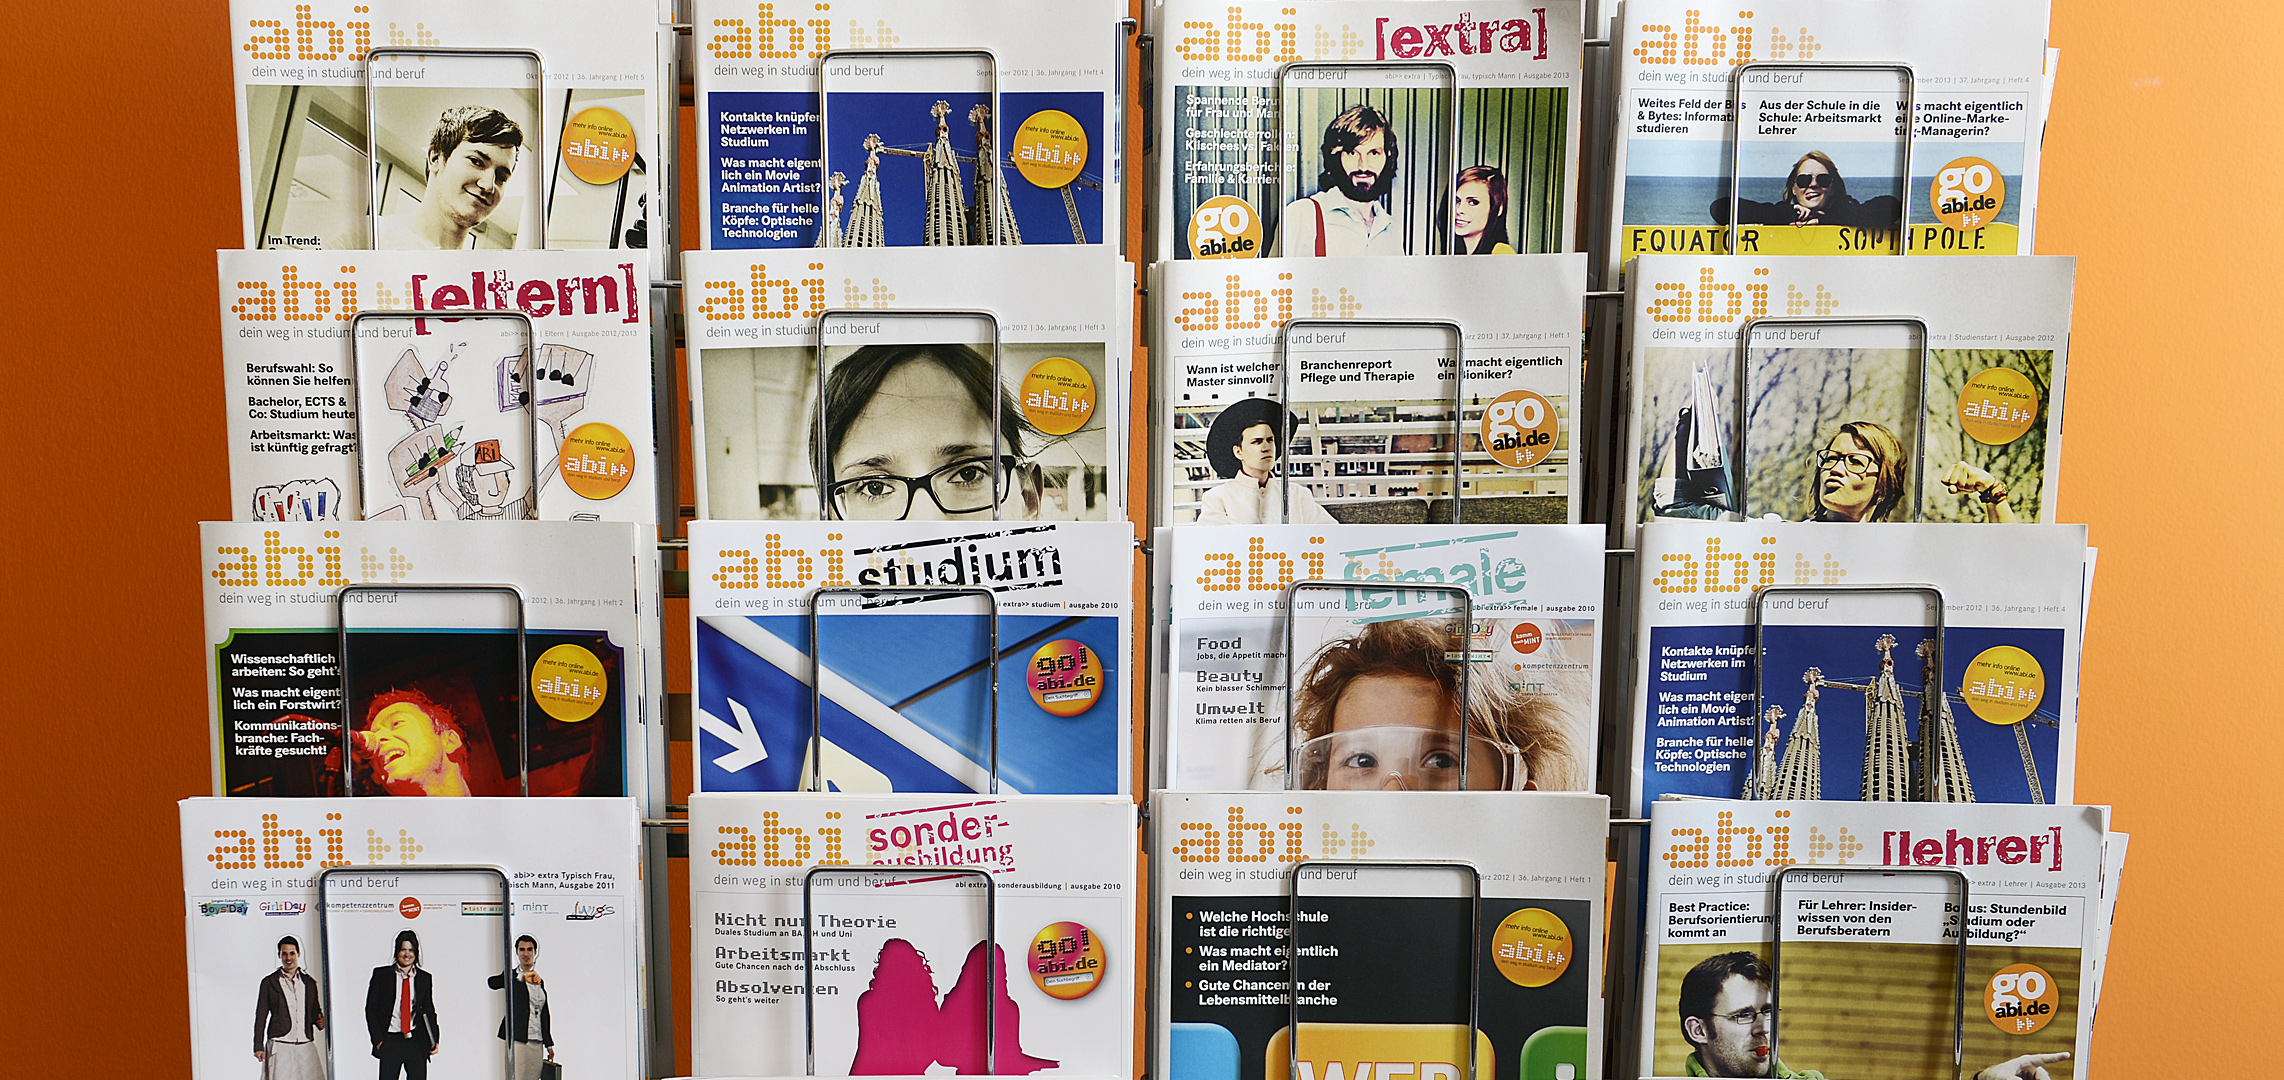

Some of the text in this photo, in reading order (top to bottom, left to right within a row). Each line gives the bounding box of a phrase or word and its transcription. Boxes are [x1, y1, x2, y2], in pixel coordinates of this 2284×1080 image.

[243, 5, 378, 61] abi
[707, 3, 830, 59] abi
[1176, 6, 1302, 62] abi
[1633, 9, 1757, 65] abi
[252, 66, 276, 77] dein
[280, 68, 304, 80] weg
[307, 67, 318, 77] in
[395, 68, 425, 79] beruf
[1182, 67, 1243, 81] dein weg in
[1186, 95, 1248, 106] Spannende
[1638, 98, 1722, 109] Weites Feld der
[720, 112, 773, 122] Kontakte
[1186, 107, 1253, 118] für Frau und
[1636, 124, 1689, 134] studieren
[1758, 125, 1797, 135] Lehrer
[721, 137, 769, 147] Studium
[567, 139, 609, 161] abi
[721, 158, 785, 168] Was macht
[1938, 165, 1993, 209] go
[722, 203, 819, 213] Branche für helle
[722, 215, 813, 228] Köpfe: Optische
[1196, 205, 1249, 250] go
[268, 235, 320, 245] Im Trend:
[722, 228, 798, 240] Technologien
[1925, 226, 1986, 250] POLE
[1200, 236, 1254, 256] abi.de
[231, 265, 358, 321] abi
[698, 262, 826, 321] abi
[1646, 267, 1773, 323] abi
[1174, 272, 1293, 331] abi
[707, 325, 772, 339] dein weg in
[1765, 329, 1821, 340] und beruf
[246, 363, 334, 373] Berufswahl: So
[1187, 362, 1280, 375] Wann ist welcher
[1300, 359, 1392, 370] Branchenreport
[247, 376, 351, 386] können Sie helfen
[1187, 374, 1275, 387] Master sinnvoll?
[1300, 371, 1415, 384] Pflege und Therapie
[248, 397, 346, 409] Bachelor, ECTS &
[1026, 390, 1069, 411] abi
[1963, 399, 2008, 421] abi
[1488, 398, 1545, 444] go
[212, 531, 349, 587] abi
[712, 533, 851, 589] abi
[1197, 537, 1330, 592] abi
[1653, 537, 1777, 593] abi
[715, 597, 784, 610] dein weg in
[1031, 601, 1061, 609] studium
[1069, 602, 1099, 610] ausgabe
[1197, 637, 1242, 650] Food
[1662, 647, 1713, 657] Kontakte
[231, 654, 336, 664] Wissenschaftlich
[1036, 647, 1088, 677] go!
[1661, 658, 1745, 669] Netzwerken im
[231, 666, 305, 677] arbeiten: So
[1196, 670, 1263, 683] Beauty
[1660, 672, 1707, 682] Studium
[232, 687, 300, 697] Was macht
[1659, 692, 1722, 702] Was macht
[1196, 702, 1265, 715] Umwelt
[1657, 716, 1715, 727] Animation
[236, 745, 327, 758] kräfte gesucht!
[1655, 762, 1730, 774] Technologien
[869, 812, 1009, 852] sonder-
[1172, 807, 1309, 863] abi
[208, 813, 351, 870] abi
[711, 811, 849, 867] abi
[1663, 811, 1796, 868] abi
[211, 877, 399, 891] dein weg in und beruf
[532, 882, 556, 890] Mann,
[559, 882, 594, 890] Ausgabe
[1669, 902, 1750, 913] Best Practice:
[715, 913, 897, 929] Nicht Theorie
[1199, 911, 1248, 922] Welche
[715, 928, 741, 936] Duales
[744, 929, 777, 937] Studium
[1668, 928, 1727, 938] kommt an
[1797, 925, 1891, 937] Berufsberatern
[1037, 928, 1091, 960] go!
[1199, 945, 1272, 957] Was macht
[1498, 940, 1544, 963] abi
[1199, 960, 1288, 971] ein Mediator?
[1199, 979, 1331, 991] Gute der
[1991, 971, 2046, 1013] go
